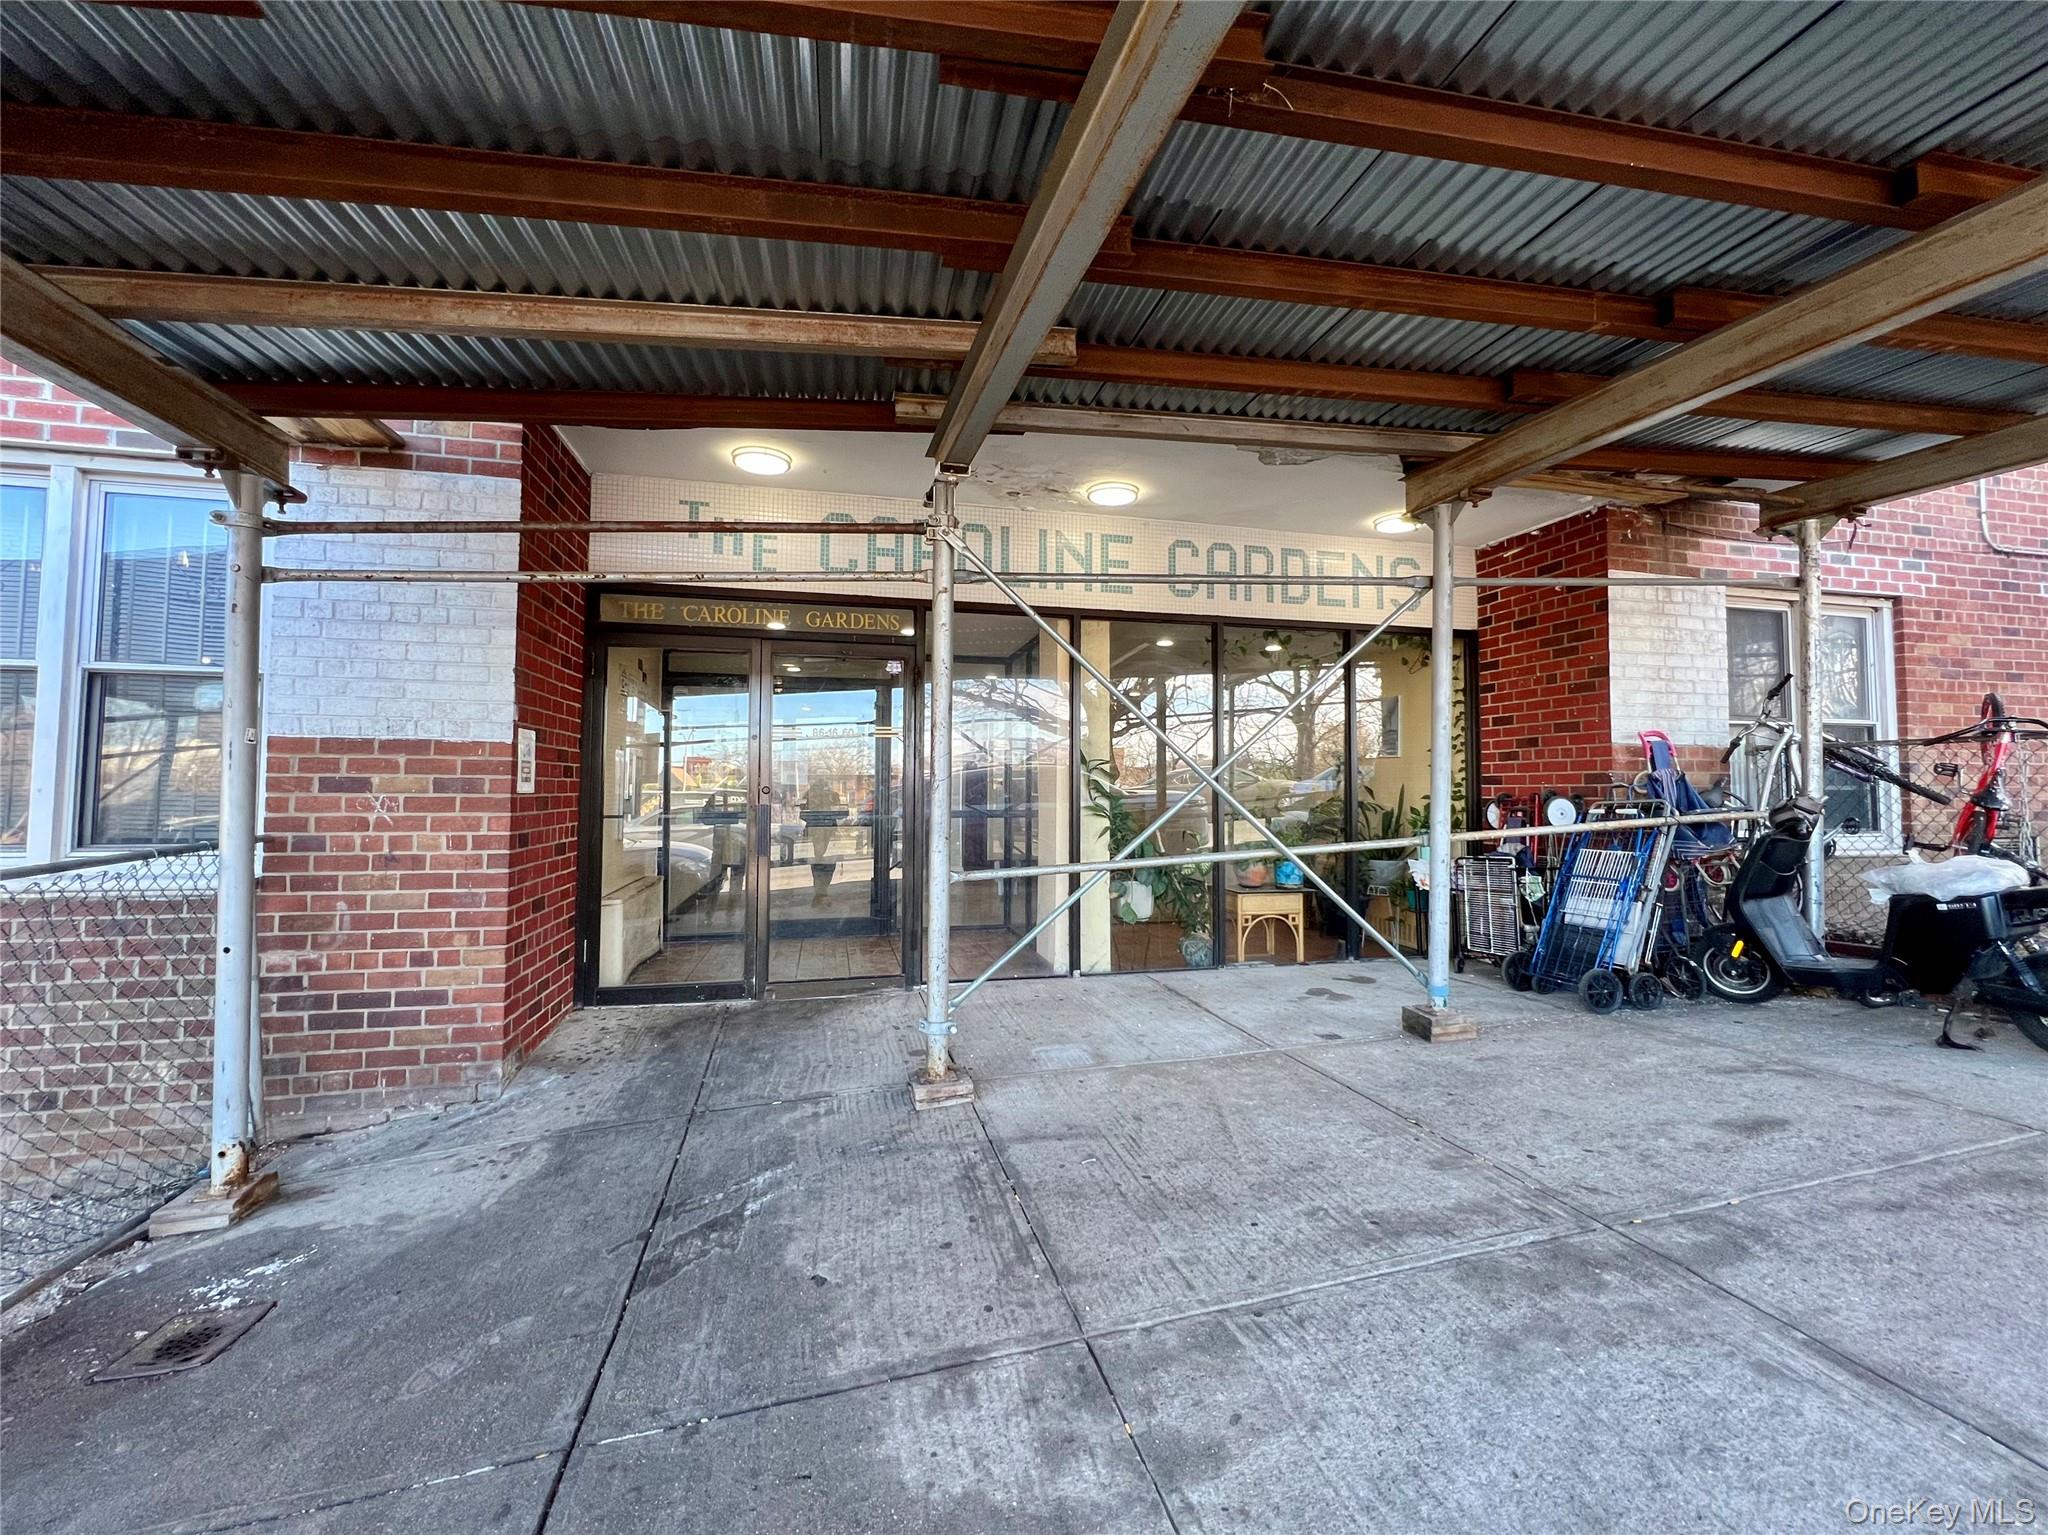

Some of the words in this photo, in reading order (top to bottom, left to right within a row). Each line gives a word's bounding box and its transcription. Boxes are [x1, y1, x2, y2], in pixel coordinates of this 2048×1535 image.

[679, 500, 777, 572] THE
[619, 600, 665, 621] THE
[682, 604, 792, 627] CAROLINE
[805, 610, 901, 631] GARDENS
